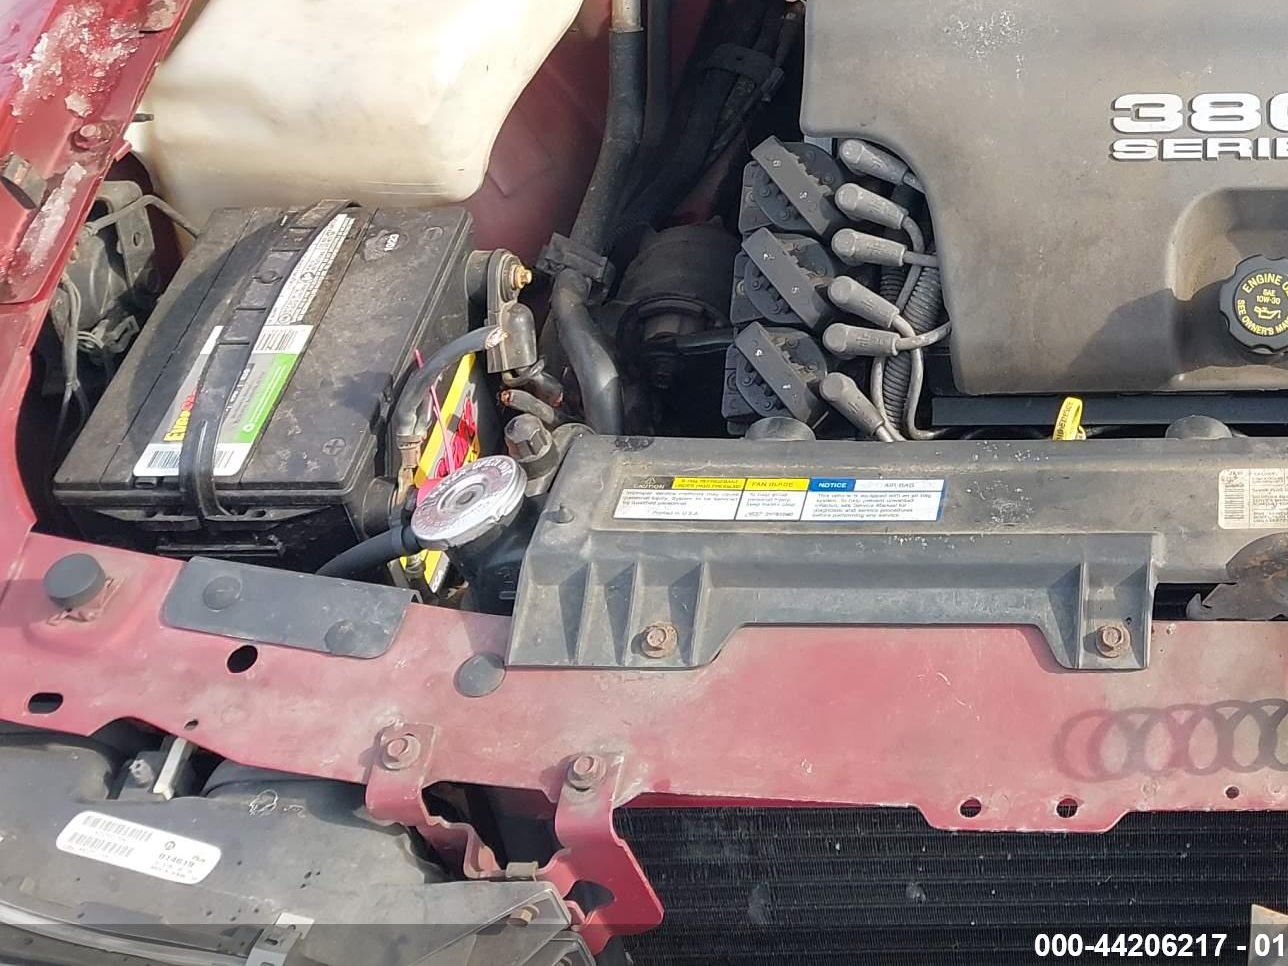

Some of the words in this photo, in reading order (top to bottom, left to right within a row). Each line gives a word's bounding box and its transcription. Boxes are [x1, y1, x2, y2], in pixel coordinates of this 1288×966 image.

[1242, 273, 1283, 294] ENGINE
[1256, 295, 1281, 305] 10W-30
[1263, 289, 1276, 297] SAE
[1237, 299, 1247, 316] SEE
[1241, 316, 1275, 336] OWNER'S
